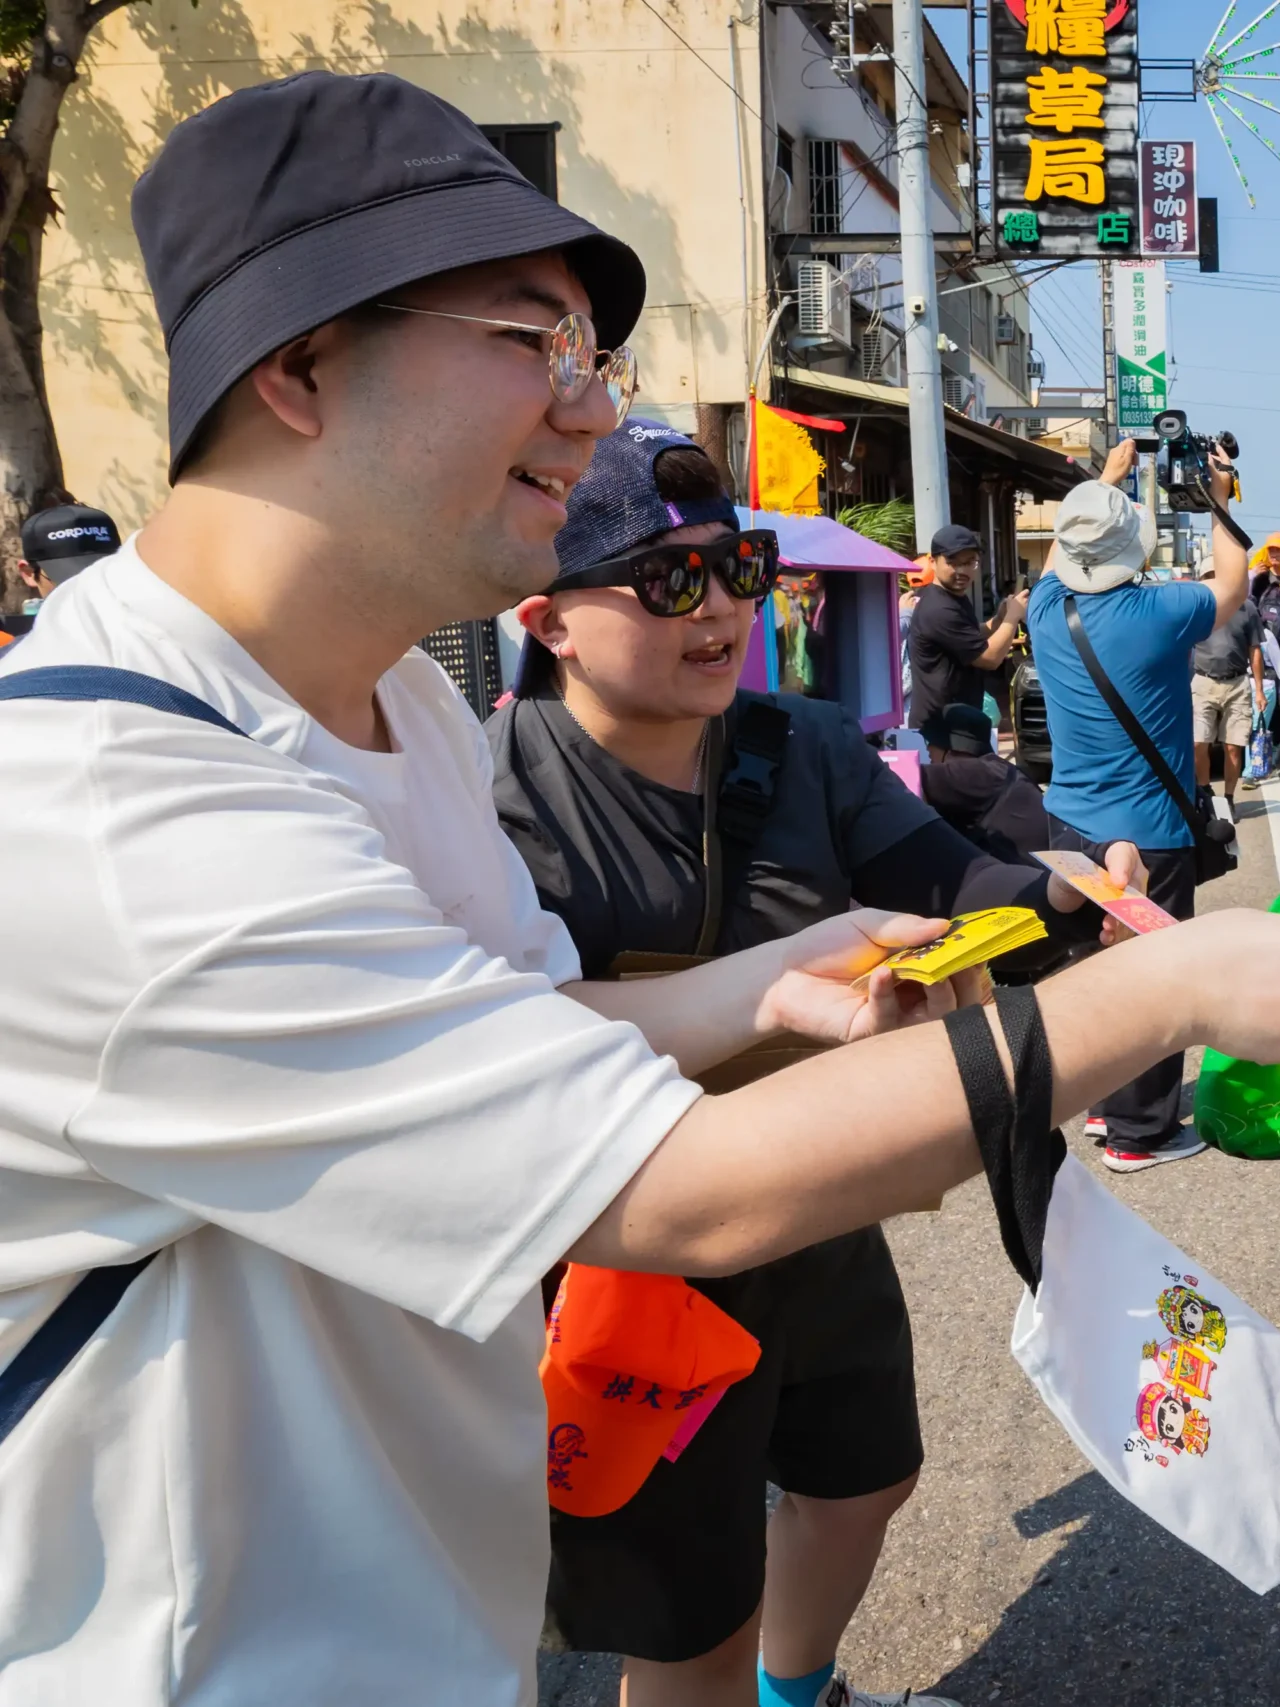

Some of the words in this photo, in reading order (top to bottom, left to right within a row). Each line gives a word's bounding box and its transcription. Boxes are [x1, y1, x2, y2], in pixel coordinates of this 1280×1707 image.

[1024, 0, 1107, 204] 糧草局
[403, 153, 461, 168] FORCLAZ
[1121, 374, 1154, 393] 明德
[47, 526, 109, 540] CORDURA
